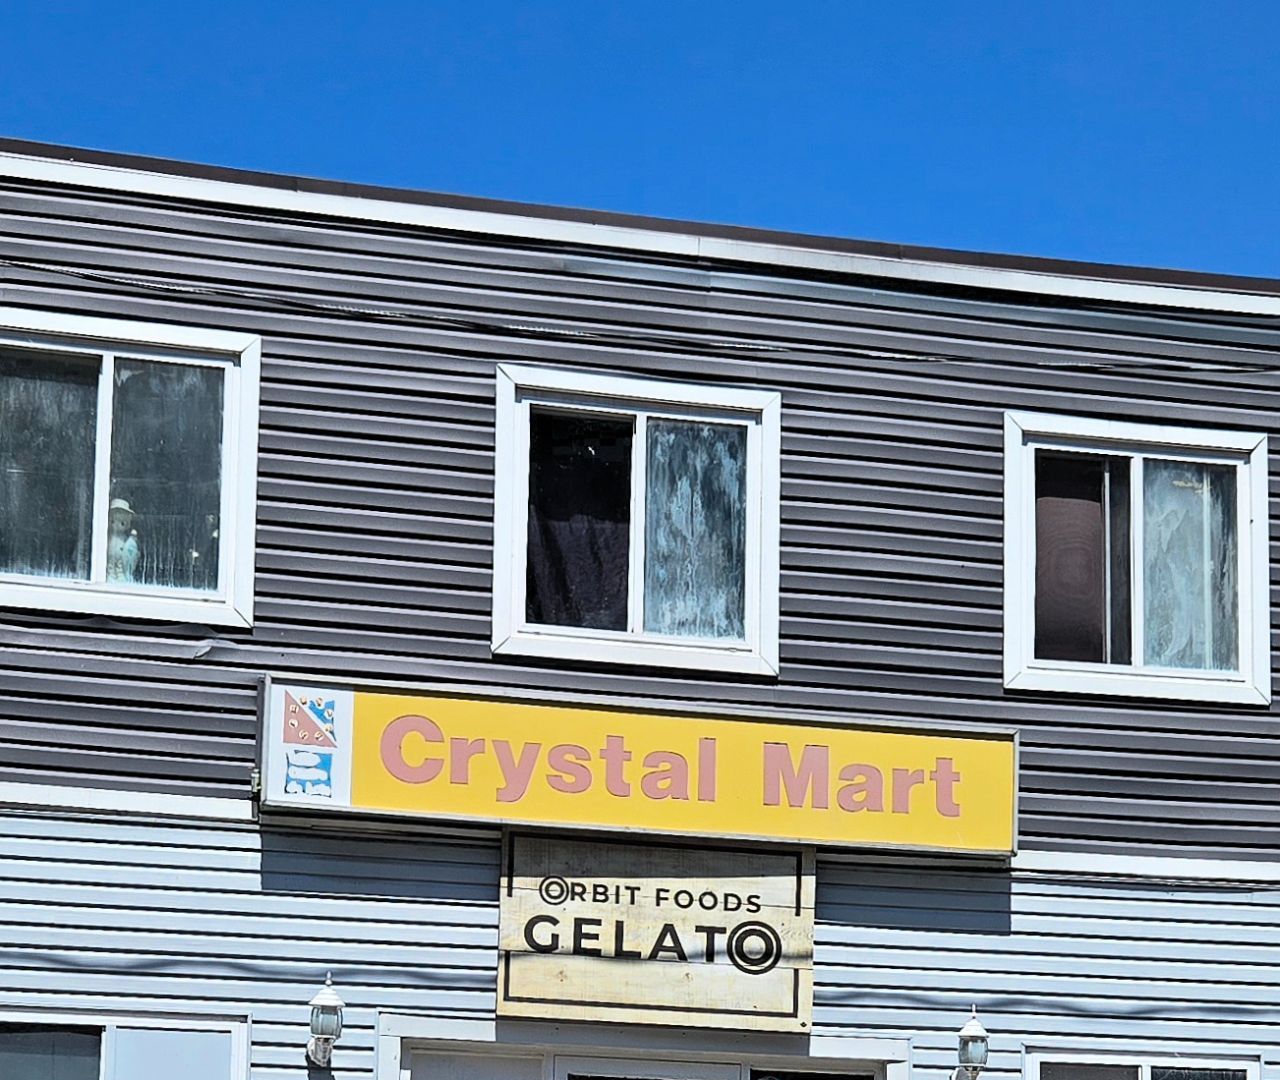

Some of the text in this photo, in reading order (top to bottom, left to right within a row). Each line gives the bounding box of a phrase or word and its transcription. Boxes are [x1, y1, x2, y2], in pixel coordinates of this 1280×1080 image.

[380, 714, 716, 802] Crystal
[763, 741, 960, 817] Mart
[539, 875, 762, 913] ORBIT FOODS
[524, 914, 782, 975] GELATO
